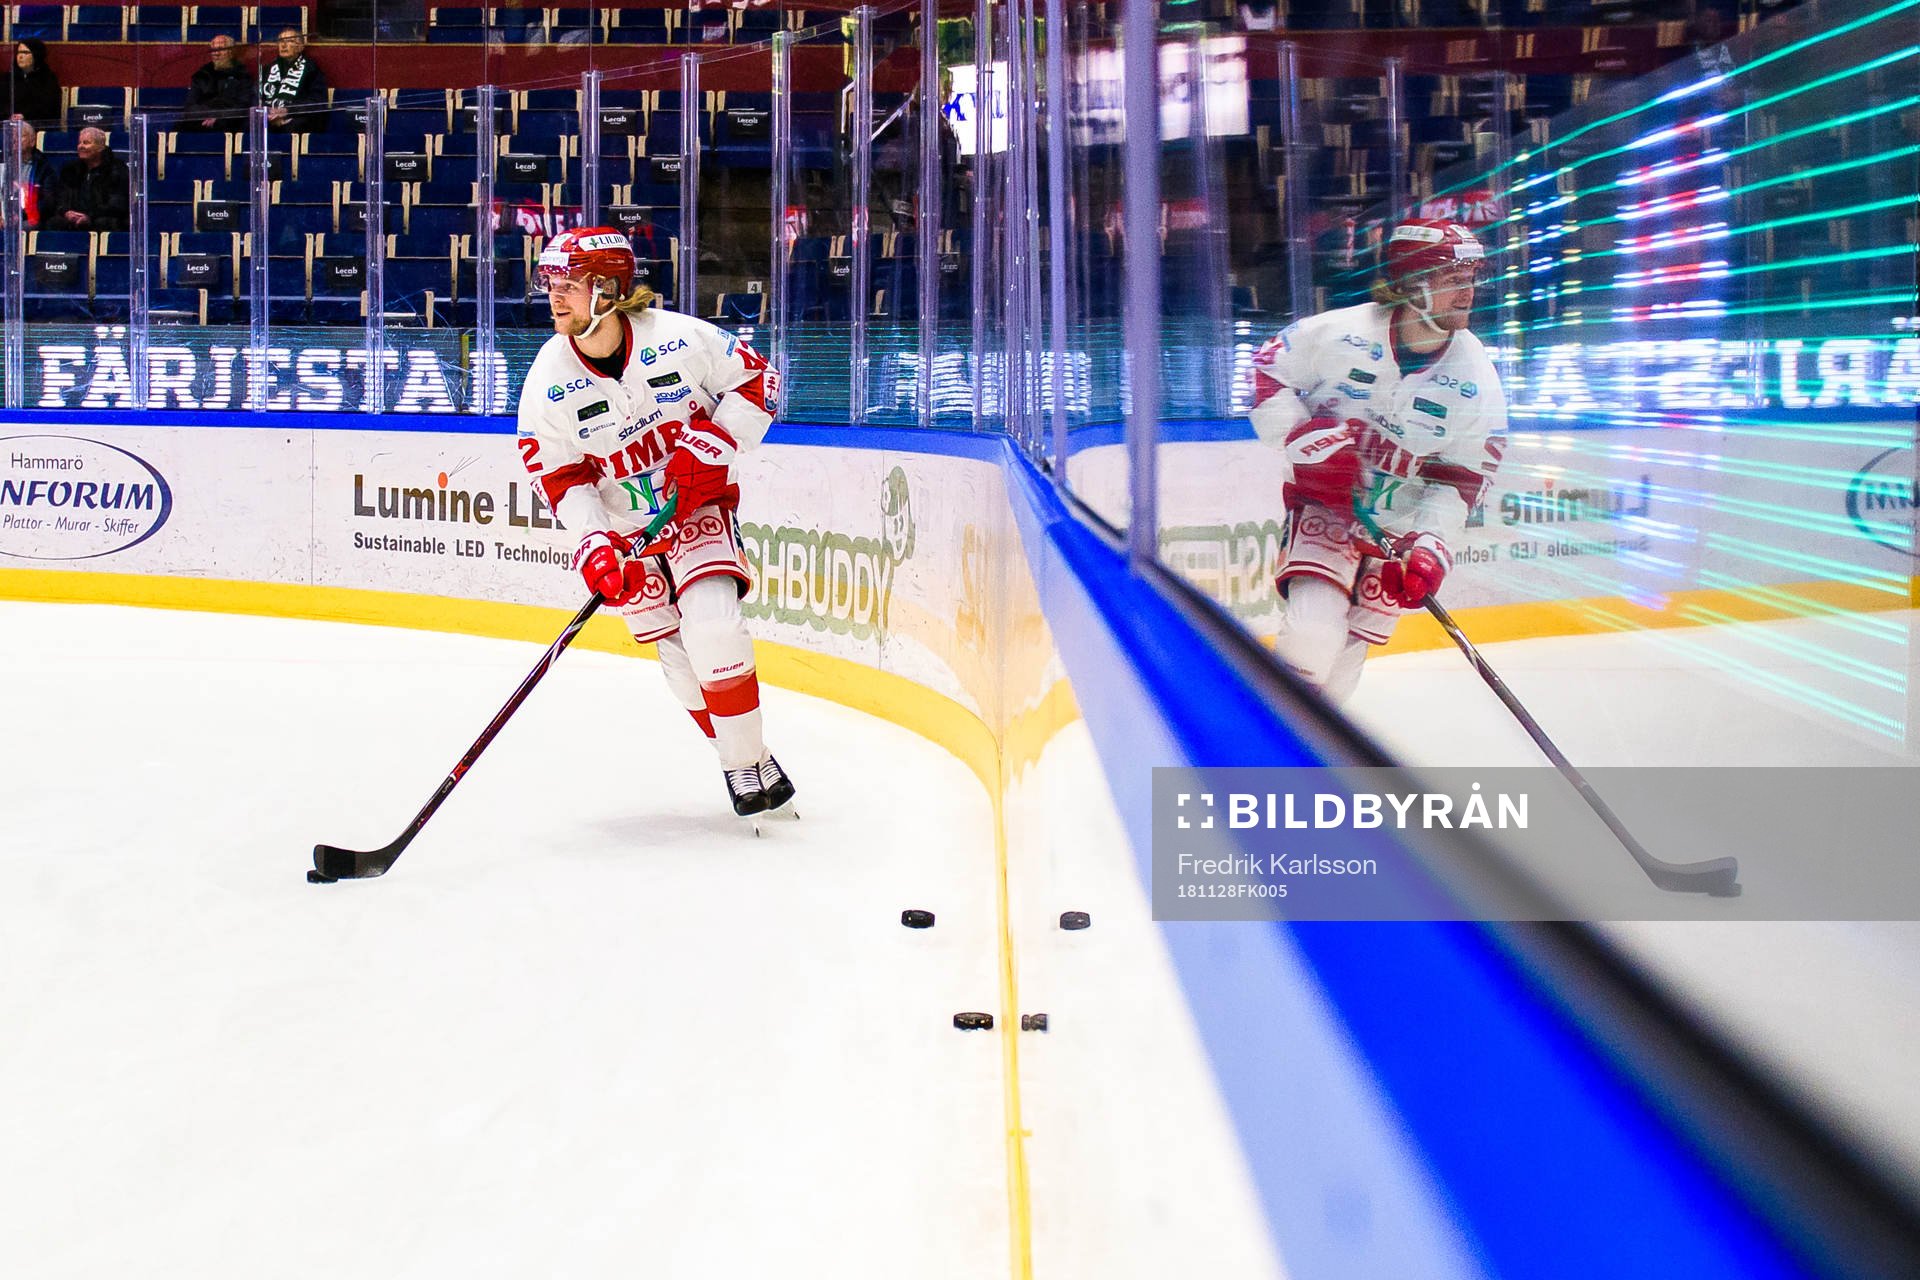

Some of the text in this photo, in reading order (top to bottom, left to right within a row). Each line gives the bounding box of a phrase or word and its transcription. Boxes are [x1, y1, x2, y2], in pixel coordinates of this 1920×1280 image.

[603, 115, 627, 123] Lecab
[395, 160, 417, 168] Lecab
[515, 162, 537, 170] Lecab
[207, 210, 229, 218] Lecab
[619, 213, 642, 221] Lecab
[45, 262, 68, 270] Lecab
[659, 338, 688, 356] SCA
[566, 377, 595, 393] SCA
[11, 452, 84, 470] Hammarö
[518, 437, 543, 473] 2
[0, 480, 154, 510] NFORUM
[353, 472, 568, 531] Lumine LE
[3, 513, 43, 530] Plattor
[54, 516, 92, 532] Murar
[103, 517, 139, 537] Skiffer
[353, 531, 446, 555] Sustainable
[455, 538, 486, 558] LED
[739, 536, 891, 631] SHBUDDY
